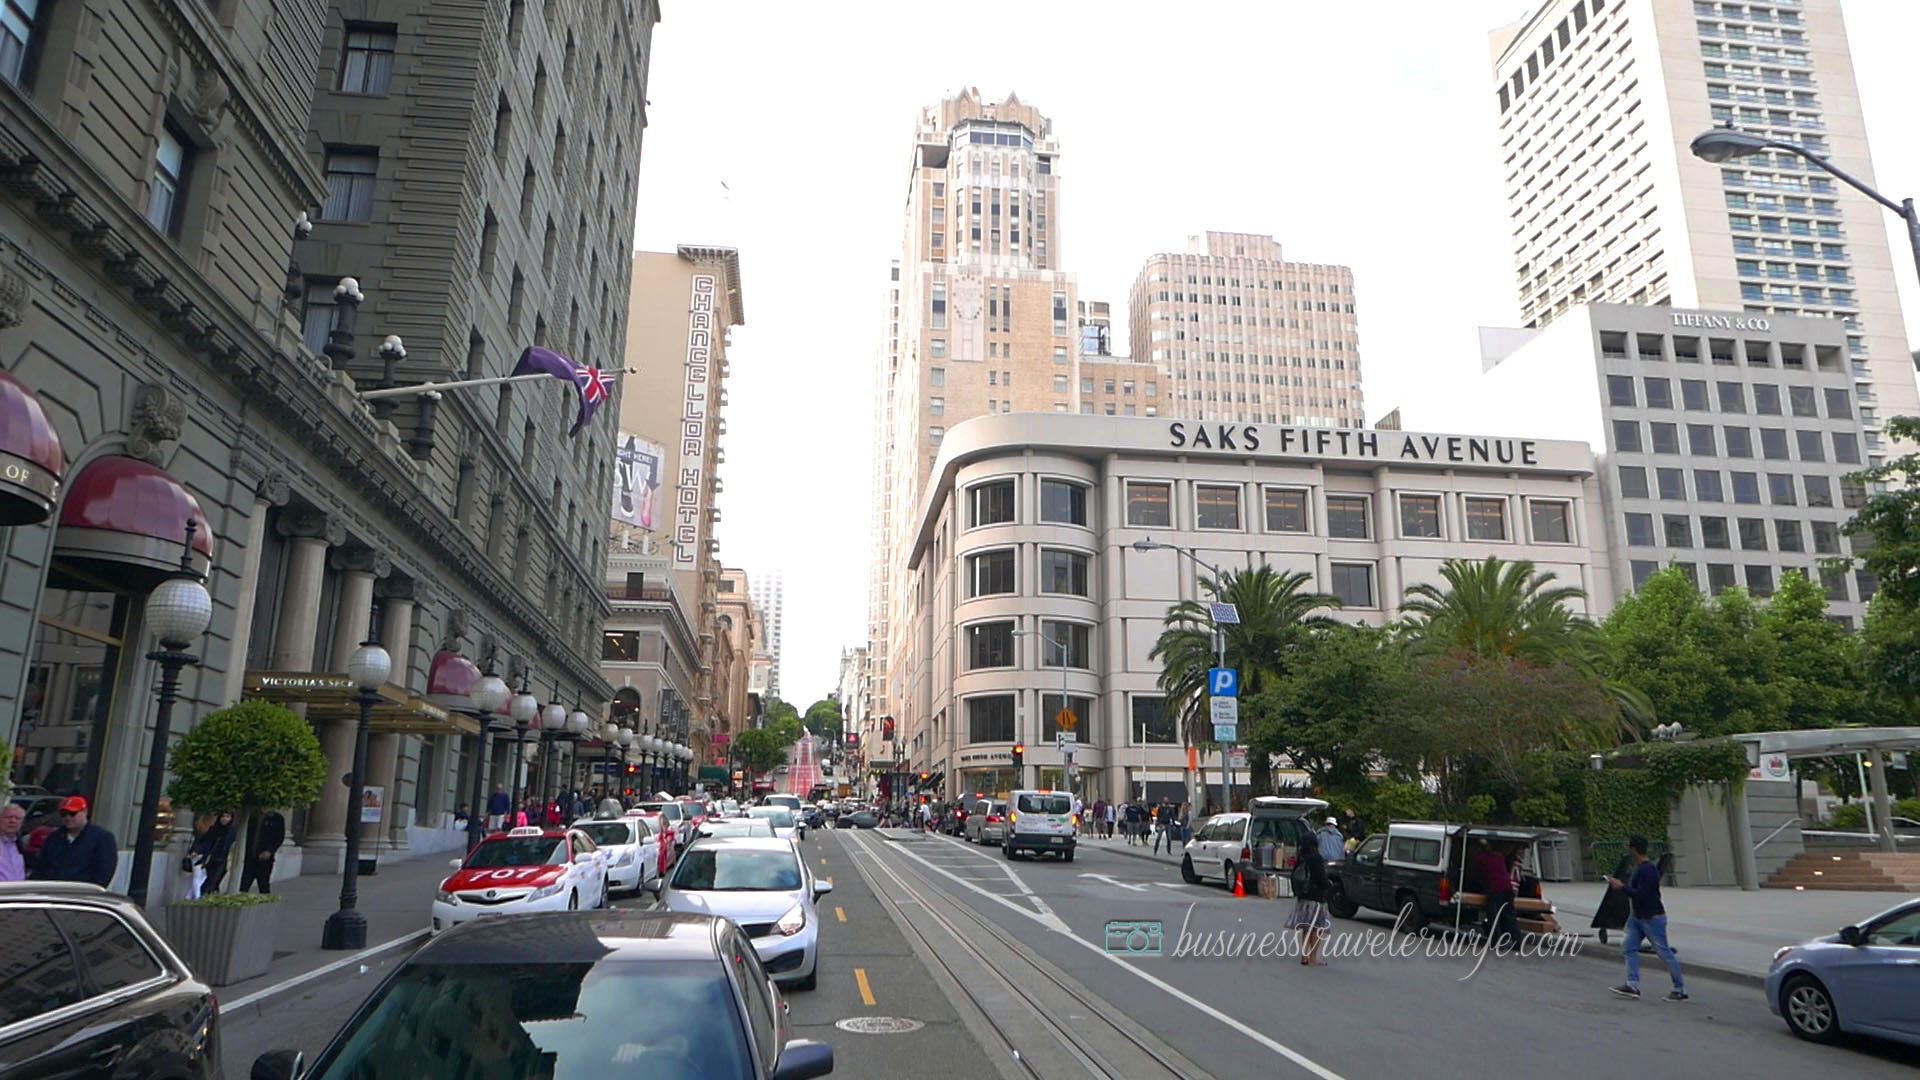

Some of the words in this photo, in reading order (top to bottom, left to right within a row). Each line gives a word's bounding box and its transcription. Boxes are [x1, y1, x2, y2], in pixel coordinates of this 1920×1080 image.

[1671, 312, 1732, 329] TIFFANY
[1735, 318, 1746, 330] &
[683, 276, 713, 456] CHANCELLOR
[1169, 422, 1260, 451] SAKS
[1280, 428, 1378, 457] FIFTH
[1400, 435, 1537, 465] AVENUE
[6, 464, 30, 482] OF
[677, 468, 700, 563] HOTEL
[262, 677, 324, 687] VICTORIA'S
[328, 679, 355, 688] SECR
[1214, 670, 1233, 694] P
[469, 868, 538, 882] 707
